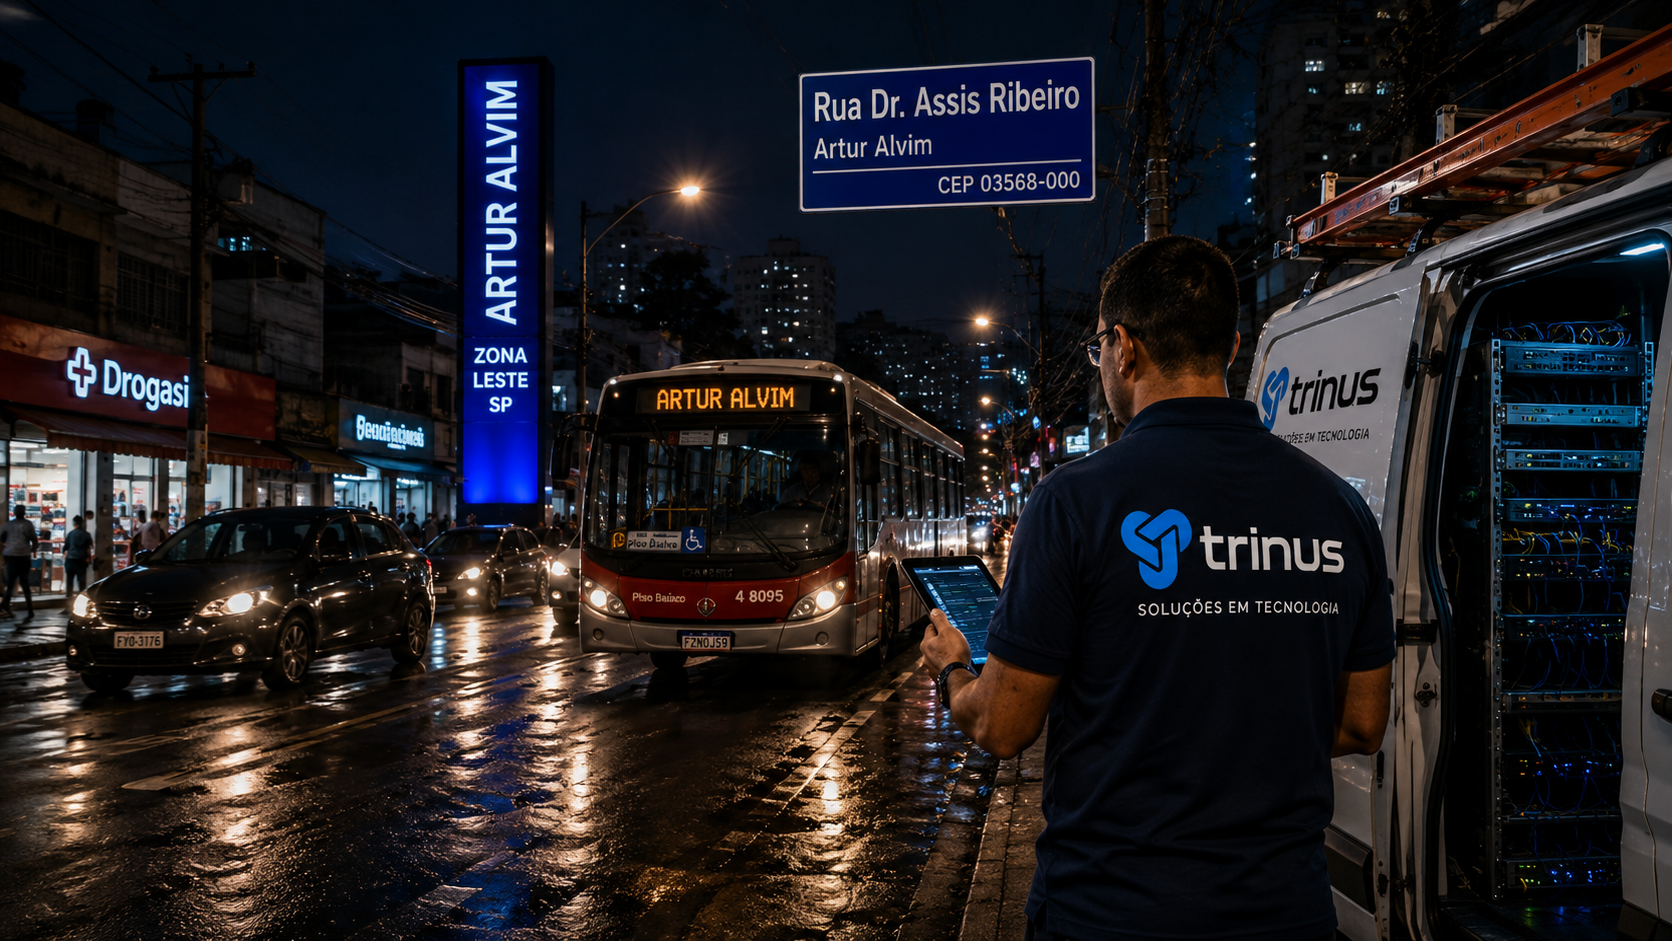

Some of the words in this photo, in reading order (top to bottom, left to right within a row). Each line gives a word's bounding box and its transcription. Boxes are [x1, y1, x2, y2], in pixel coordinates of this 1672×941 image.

[814, 91, 862, 122] Rua
[871, 88, 905, 119] Dr.
[914, 84, 980, 117] Assis
[990, 79, 1080, 114] Ribeiro
[485, 79, 518, 192] ALVIM
[813, 137, 868, 160] Artur
[874, 133, 932, 158] Alvim
[938, 175, 974, 194] CEP
[980, 170, 1080, 193] 03568-000
[485, 202, 518, 326] ARTUR
[473, 347, 528, 364] ZONA
[103, 359, 189, 412] Drogasi
[473, 371, 529, 389] LESTE
[1288, 367, 1382, 416] trinus
[488, 396, 514, 413] SP
[656, 388, 723, 411] ARTUR
[730, 386, 795, 409] ALVIM
[1317, 428, 1370, 442] TECNOLOGIA
[1199, 525, 1345, 574] trinus
[735, 589, 745, 603] 4
[748, 589, 784, 603] 8095
[1138, 598, 1223, 618] SOLUÇÕES
[1228, 600, 1249, 614] EM
[1254, 600, 1340, 615] TECNOLOGIA
